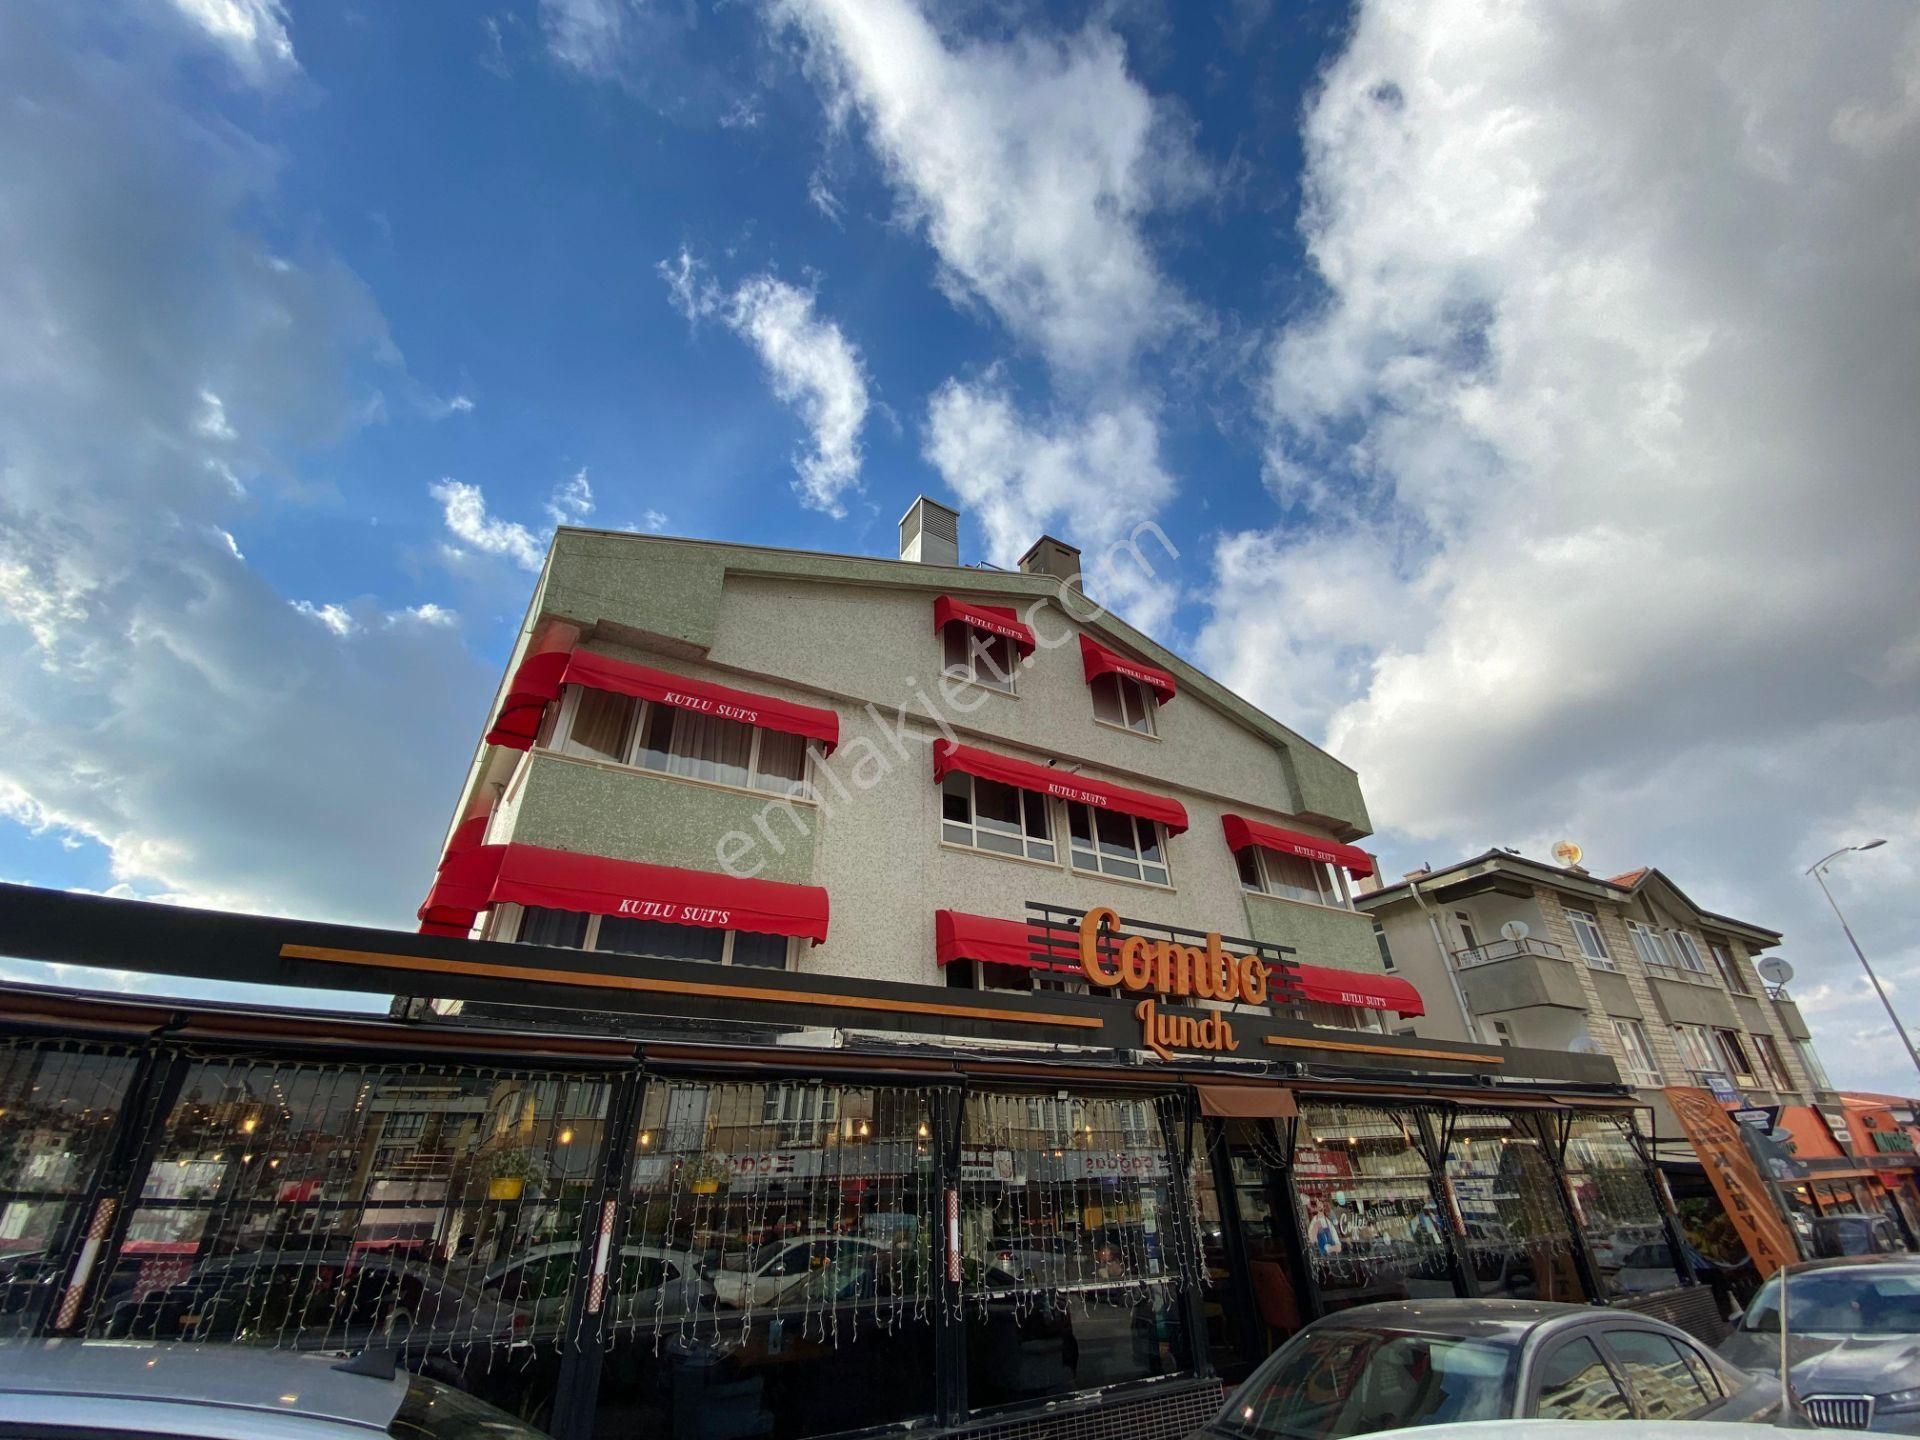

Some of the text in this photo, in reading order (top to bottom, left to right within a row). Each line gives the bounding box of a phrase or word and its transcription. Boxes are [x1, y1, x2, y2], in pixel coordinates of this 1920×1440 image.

[964, 614, 994, 630] KUTLU
[1116, 665, 1141, 679] KUTLU
[663, 692, 713, 711] KUTLU
[1048, 783, 1078, 798] KUTLU
[1294, 845, 1316, 857] KUTLU
[618, 899, 677, 918] KUTLU
[1079, 906, 1272, 1005] Combo
[1341, 991, 1364, 1004] KUTLU
[1135, 998, 1240, 1061] Lunch
